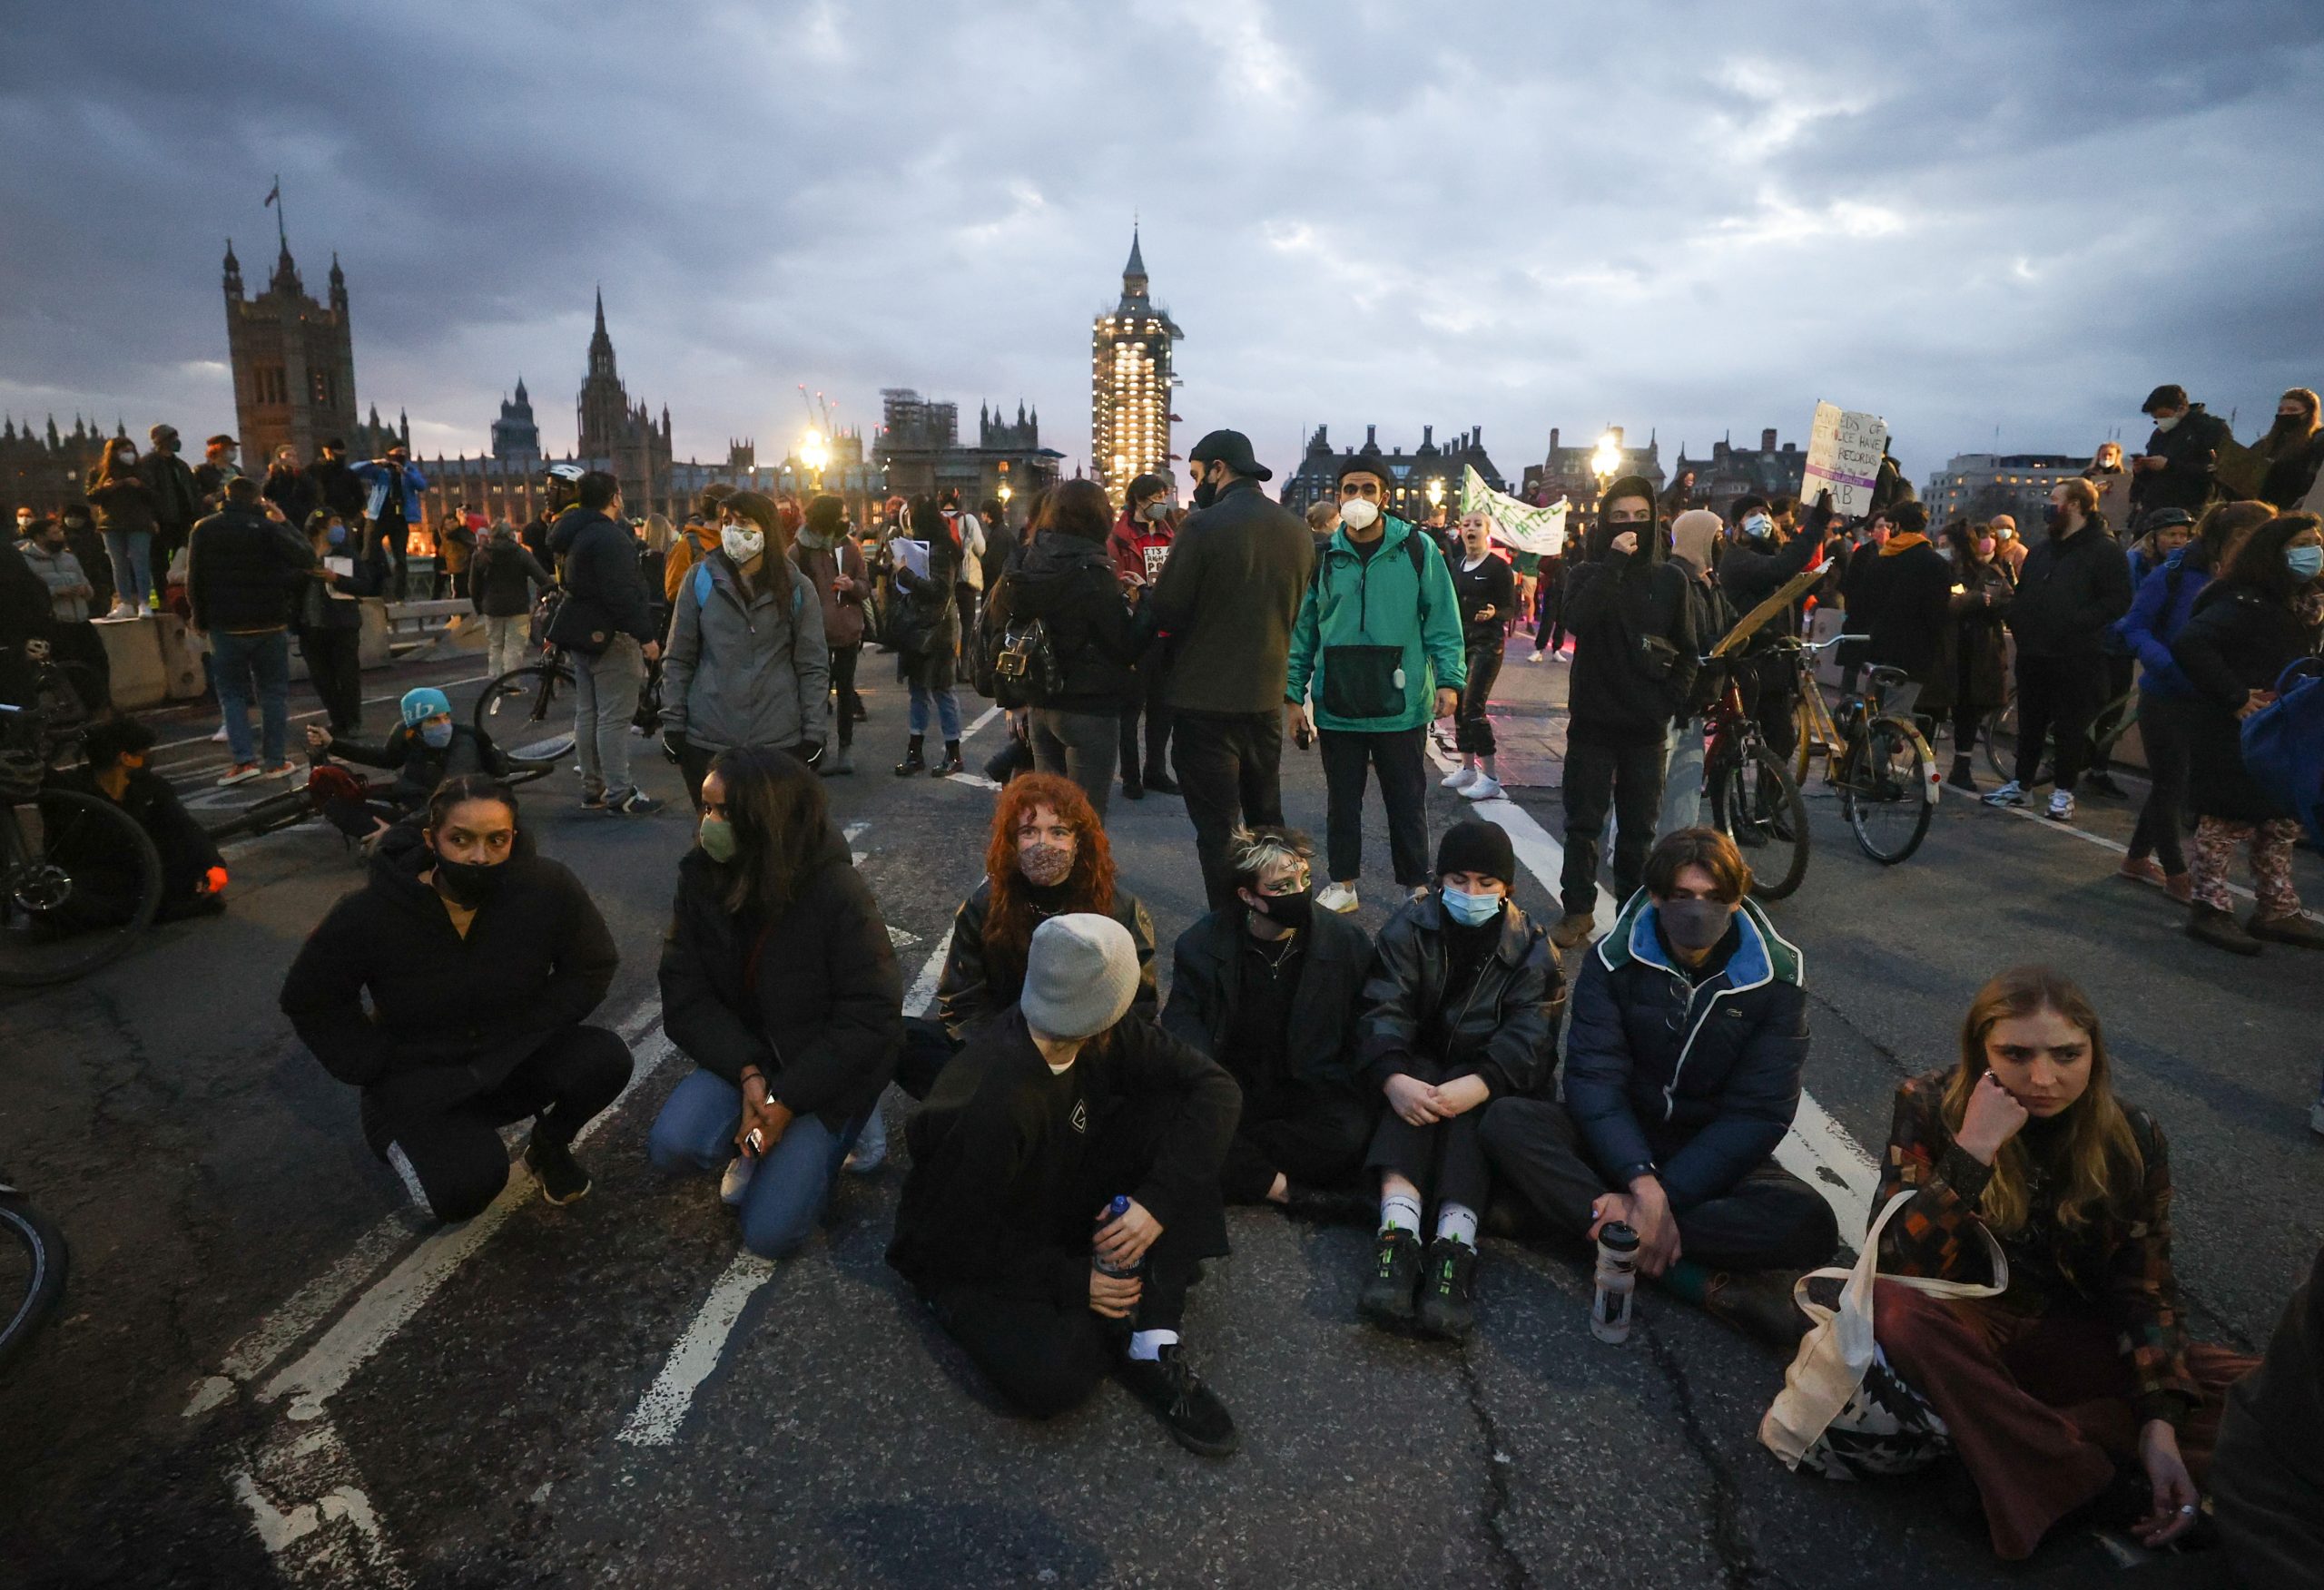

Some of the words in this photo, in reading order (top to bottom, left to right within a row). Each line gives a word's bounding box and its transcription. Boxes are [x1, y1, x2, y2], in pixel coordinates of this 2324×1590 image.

[1859, 434, 1882, 451] HAVE
[1837, 448, 1876, 466] RECORDS
[1144, 546, 1163, 555] IT'S
